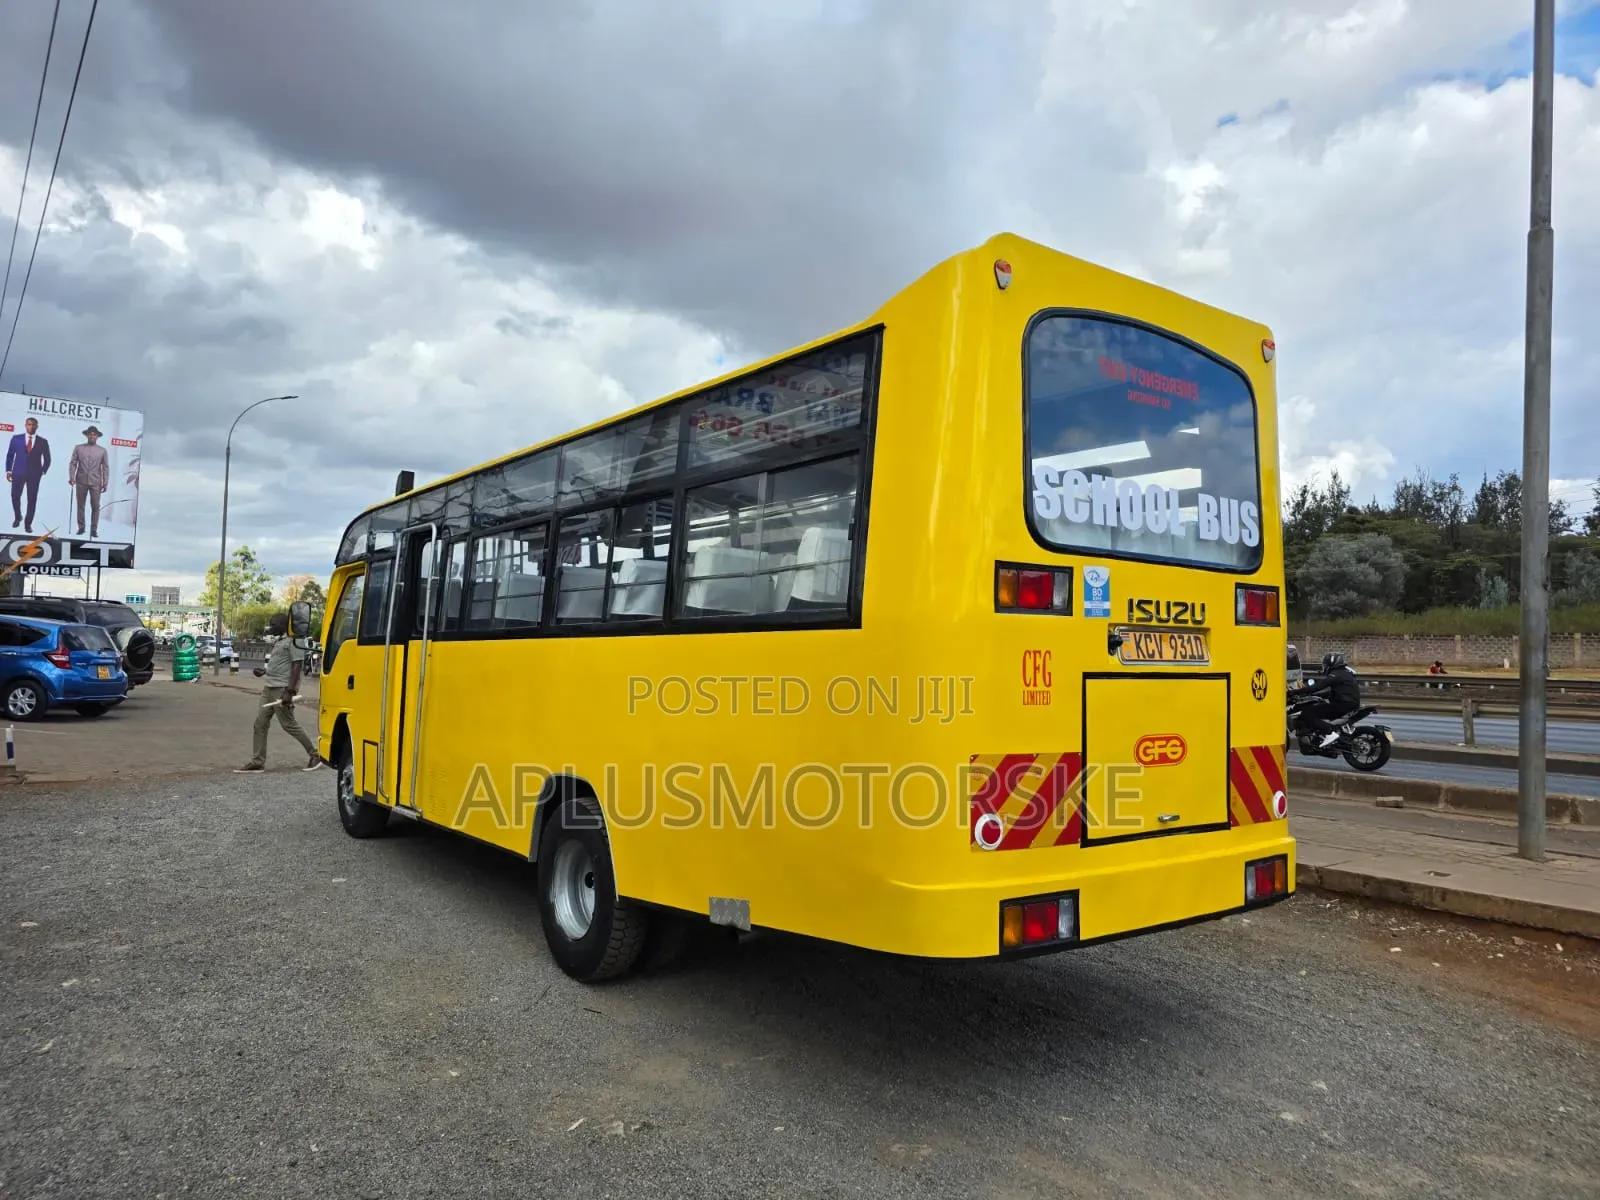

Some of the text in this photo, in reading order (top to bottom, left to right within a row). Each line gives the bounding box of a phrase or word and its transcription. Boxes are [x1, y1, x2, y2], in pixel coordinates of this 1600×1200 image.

[29, 398, 101, 420] HILLCREST
[1033, 465, 1260, 547] SCHOOL BUS
[20, 565, 81, 576] LOUNGE
[1127, 598, 1206, 625] ISUZU
[1133, 632, 1205, 660] KCV 931D
[1022, 650, 1052, 688] CFG
[1253, 672, 1267, 690] 80
[1022, 690, 1051, 706] LIMITED
[1139, 739, 1183, 762] CFG
